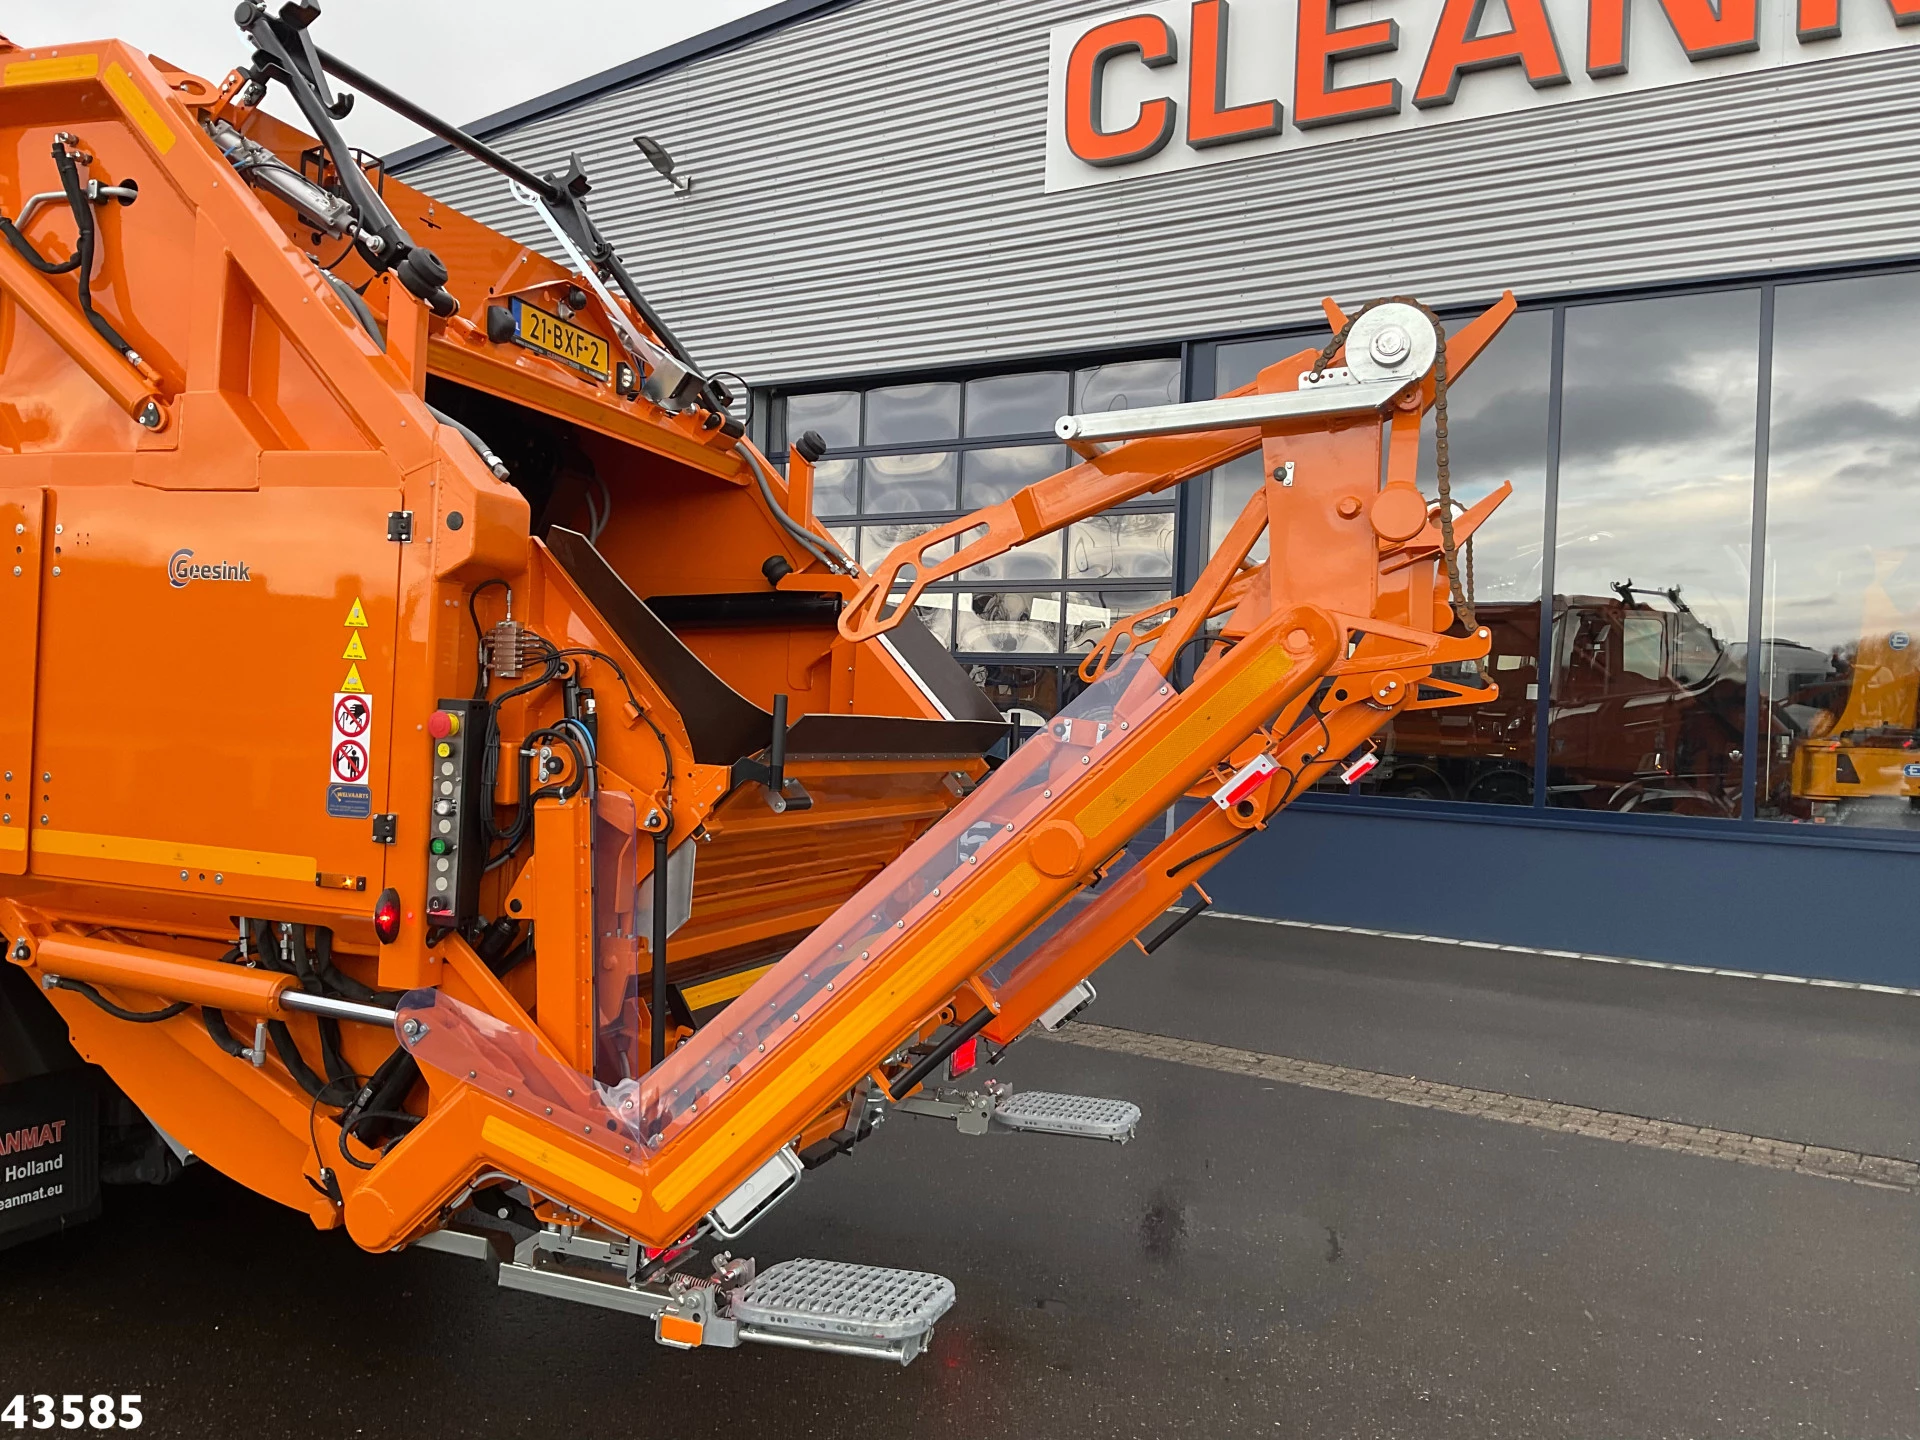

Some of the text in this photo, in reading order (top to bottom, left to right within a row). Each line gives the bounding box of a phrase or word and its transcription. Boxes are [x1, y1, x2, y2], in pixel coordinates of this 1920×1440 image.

[1065, 0, 1920, 167] CLEAN
[530, 313, 599, 366] 21-BXF-2
[174, 556, 250, 582] Geesink
[5, 1154, 63, 1182] Holland
